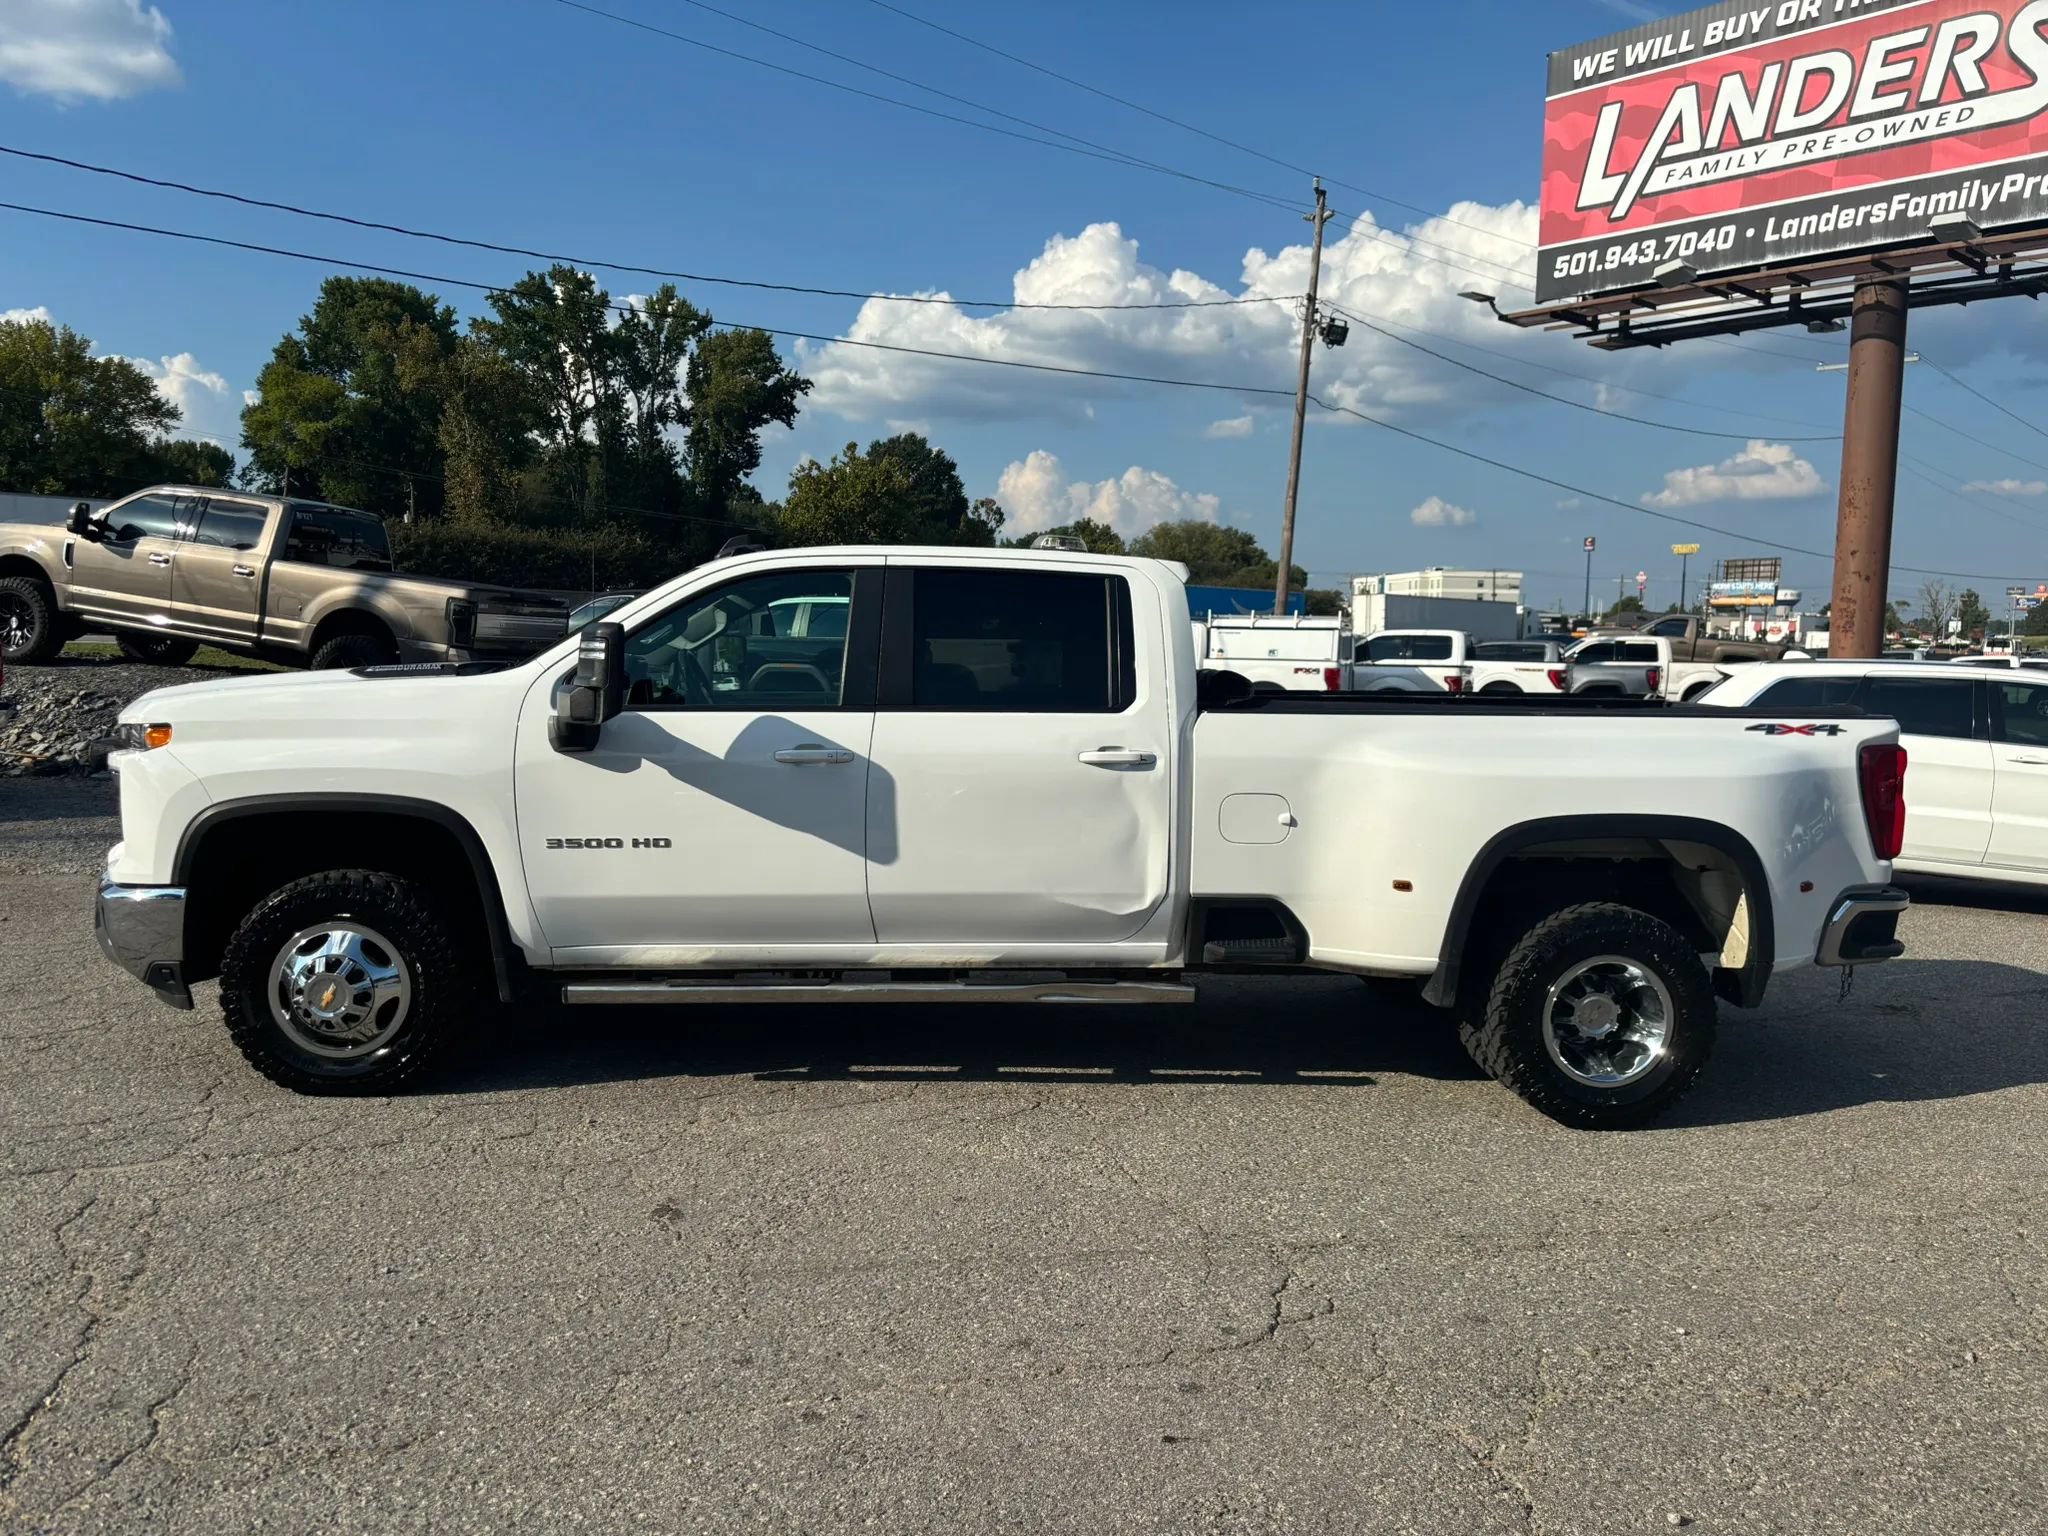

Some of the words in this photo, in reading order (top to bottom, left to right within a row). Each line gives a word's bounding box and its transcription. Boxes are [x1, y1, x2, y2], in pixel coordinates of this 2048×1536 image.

[1573, 49, 1618, 81] WE
[1625, 30, 1695, 67] WILL
[1703, 7, 1772, 47] BUY
[1776, 0, 1822, 27] OR
[1665, 149, 1768, 184] FAMILY
[1784, 107, 1975, 158] PRE-OWNED
[1553, 225, 1737, 279] 501.943.7040
[396, 663, 442, 671] DURAMAX
[1294, 667, 1321, 675] FX4
[545, 838, 624, 849] 3500
[631, 838, 672, 848] HD
